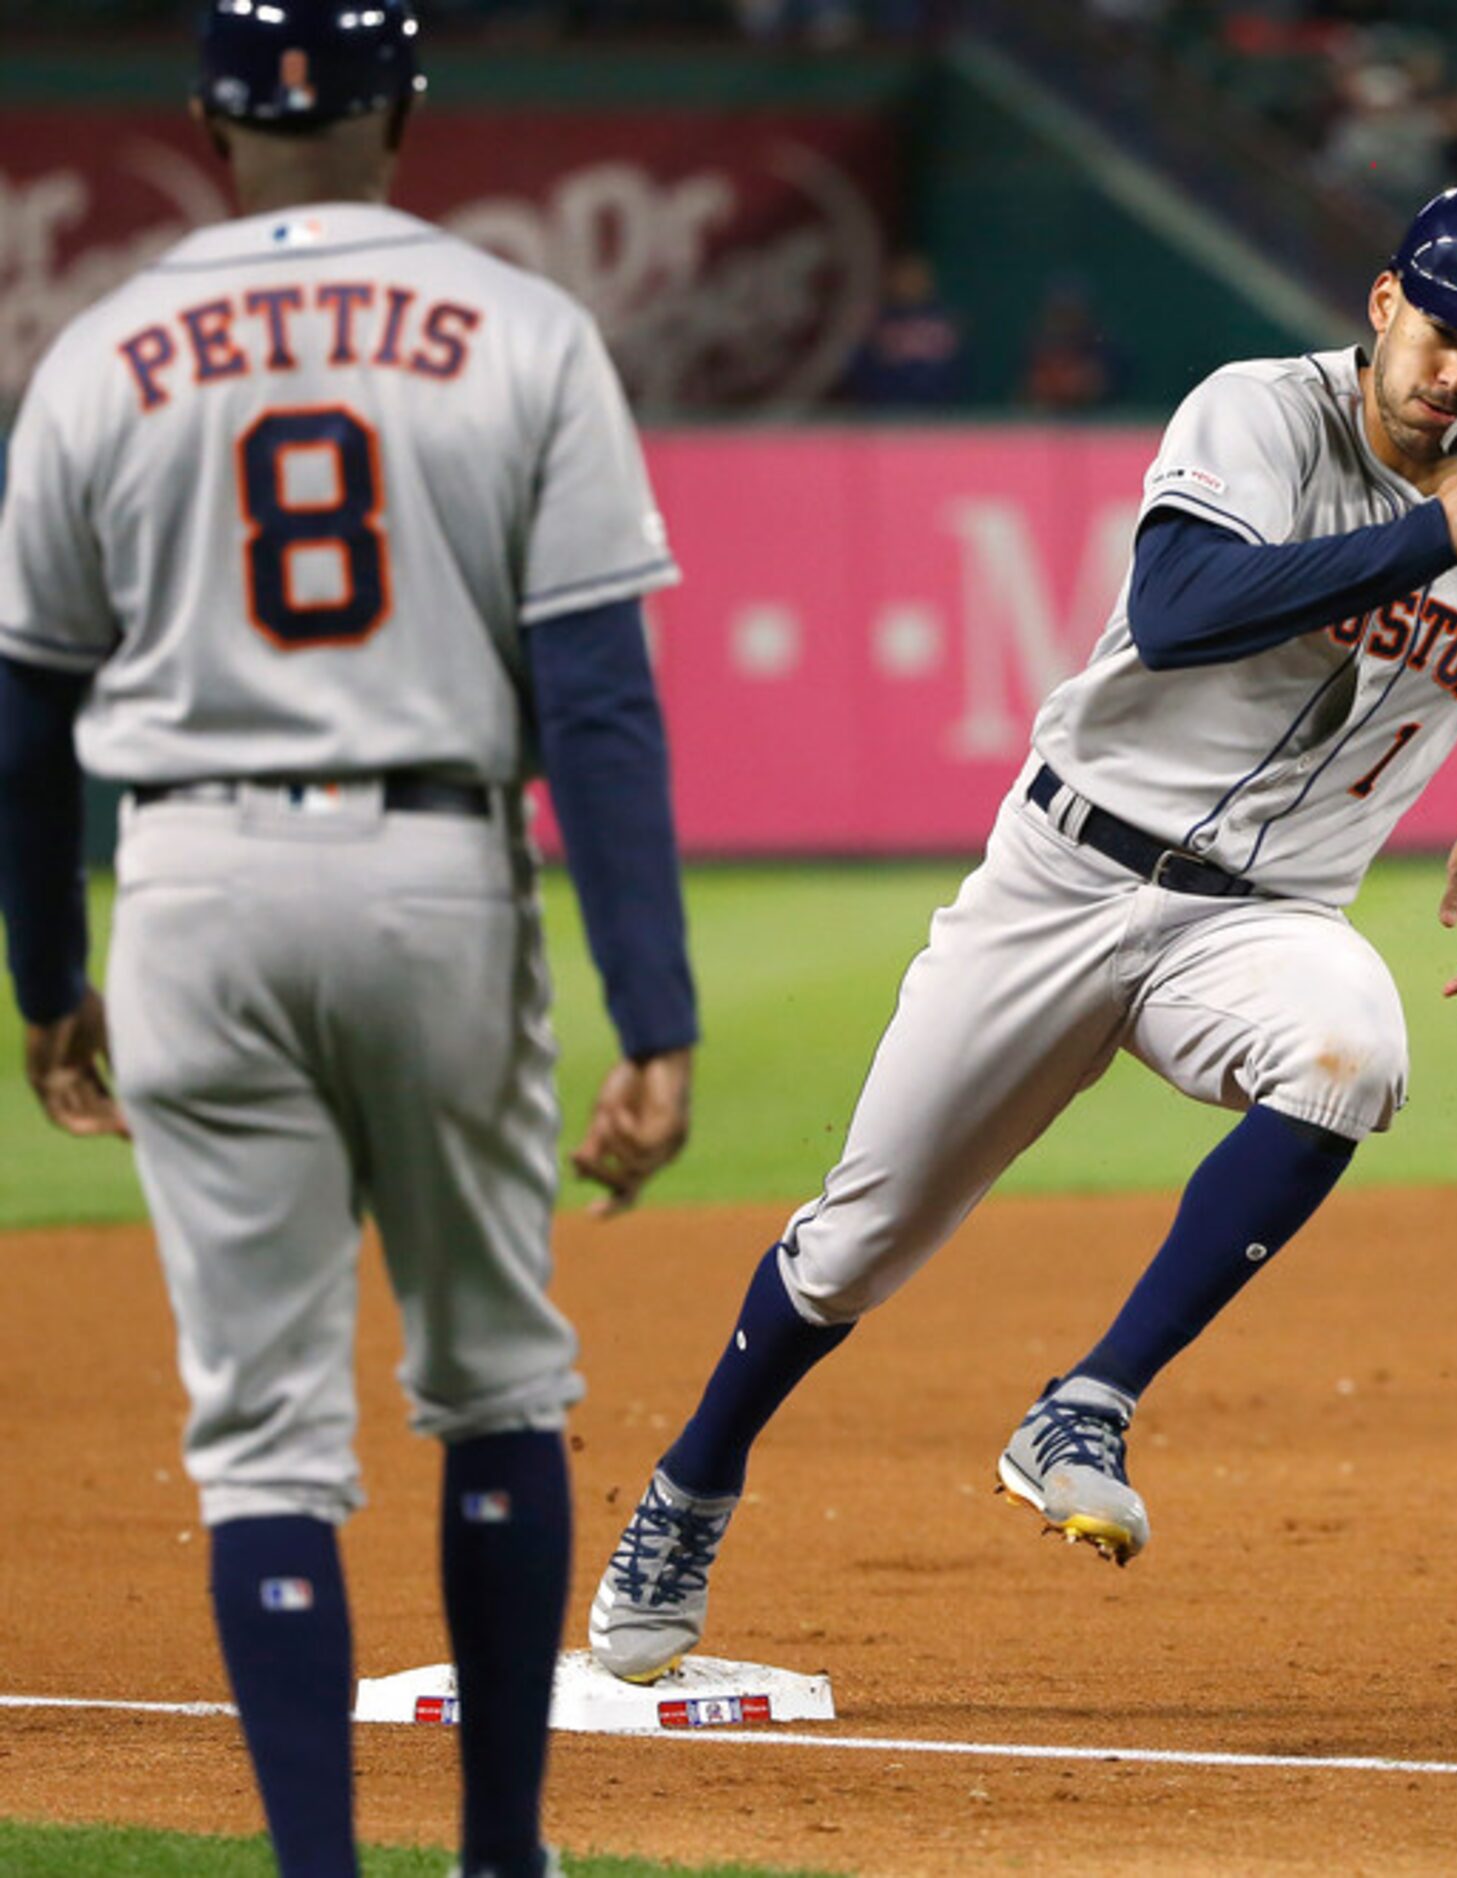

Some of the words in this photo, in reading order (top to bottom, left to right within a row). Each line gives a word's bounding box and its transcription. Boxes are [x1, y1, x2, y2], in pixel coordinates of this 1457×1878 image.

[119, 284, 483, 411] PETTIS
[235, 404, 394, 653] 8
[1347, 721, 1424, 799] 1
